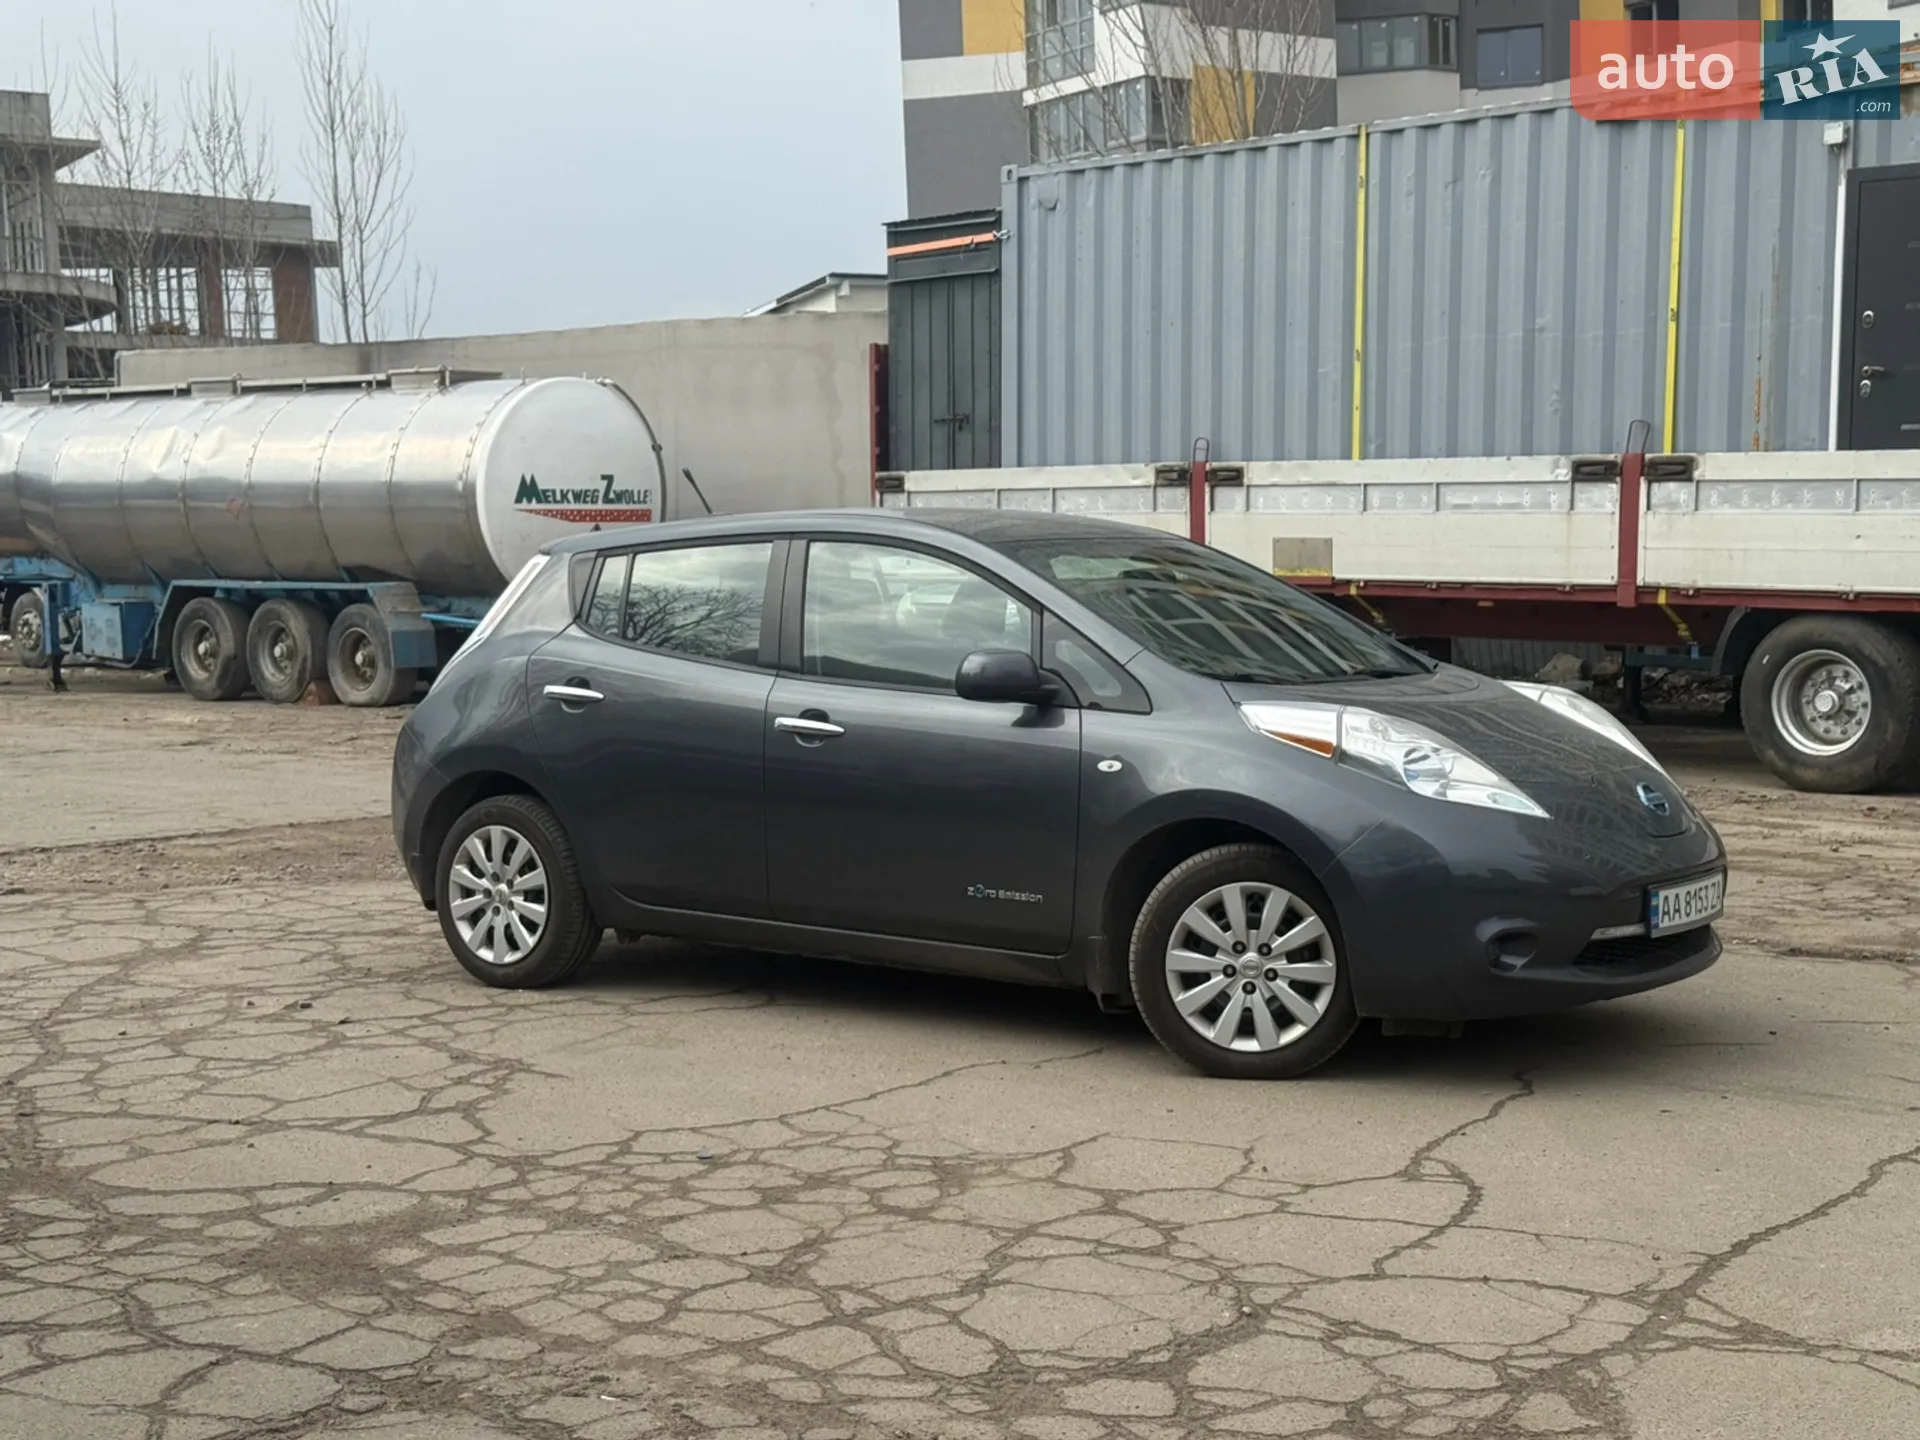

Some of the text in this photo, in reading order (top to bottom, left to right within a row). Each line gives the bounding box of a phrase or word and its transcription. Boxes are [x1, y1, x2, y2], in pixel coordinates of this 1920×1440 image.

[514, 472, 600, 504] MELKWEG
[600, 474, 650, 504] ZWOLLE
[1661, 893, 1682, 923] AA
[1684, 885, 1709, 918] 8153
